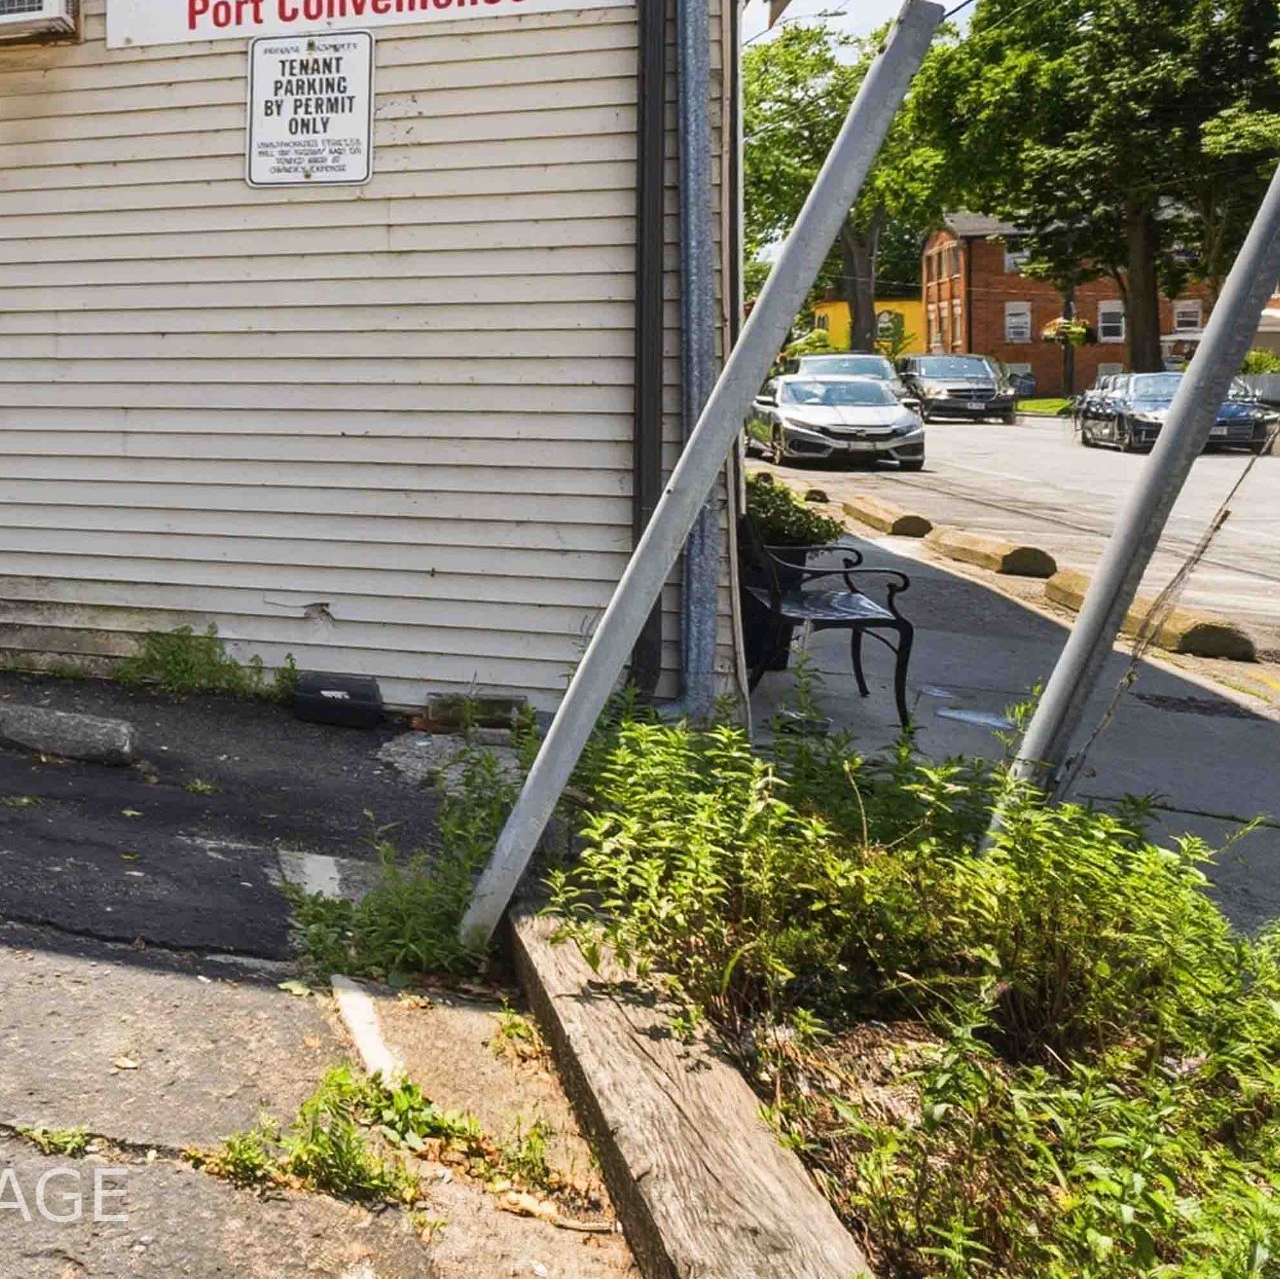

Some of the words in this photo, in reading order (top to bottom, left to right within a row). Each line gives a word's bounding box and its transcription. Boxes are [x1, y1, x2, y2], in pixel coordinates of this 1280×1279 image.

[279, 57, 343, 77] TENANT
[274, 77, 348, 97] PARKING
[264, 99, 284, 117] BY
[293, 95, 356, 116] PERMIT
[288, 117, 330, 135] ONLY
